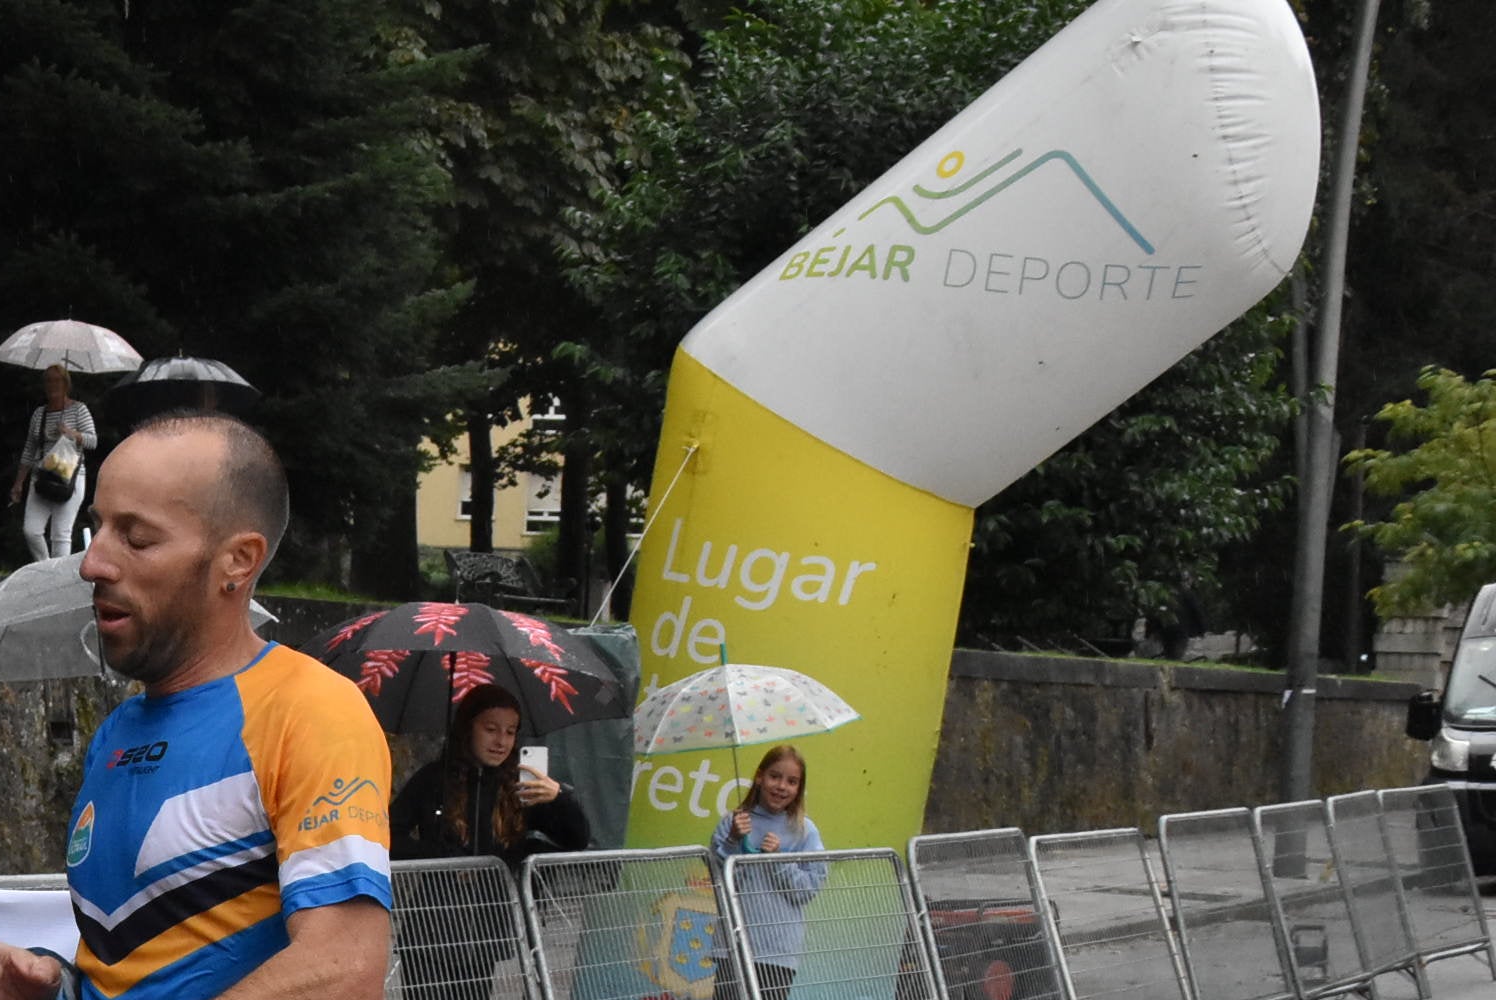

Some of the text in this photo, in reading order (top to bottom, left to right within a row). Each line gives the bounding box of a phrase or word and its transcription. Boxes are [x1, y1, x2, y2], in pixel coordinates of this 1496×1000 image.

[943, 248, 1202, 301] DEPORTE
[662, 517, 877, 611] Lugar
[650, 596, 726, 664] de
